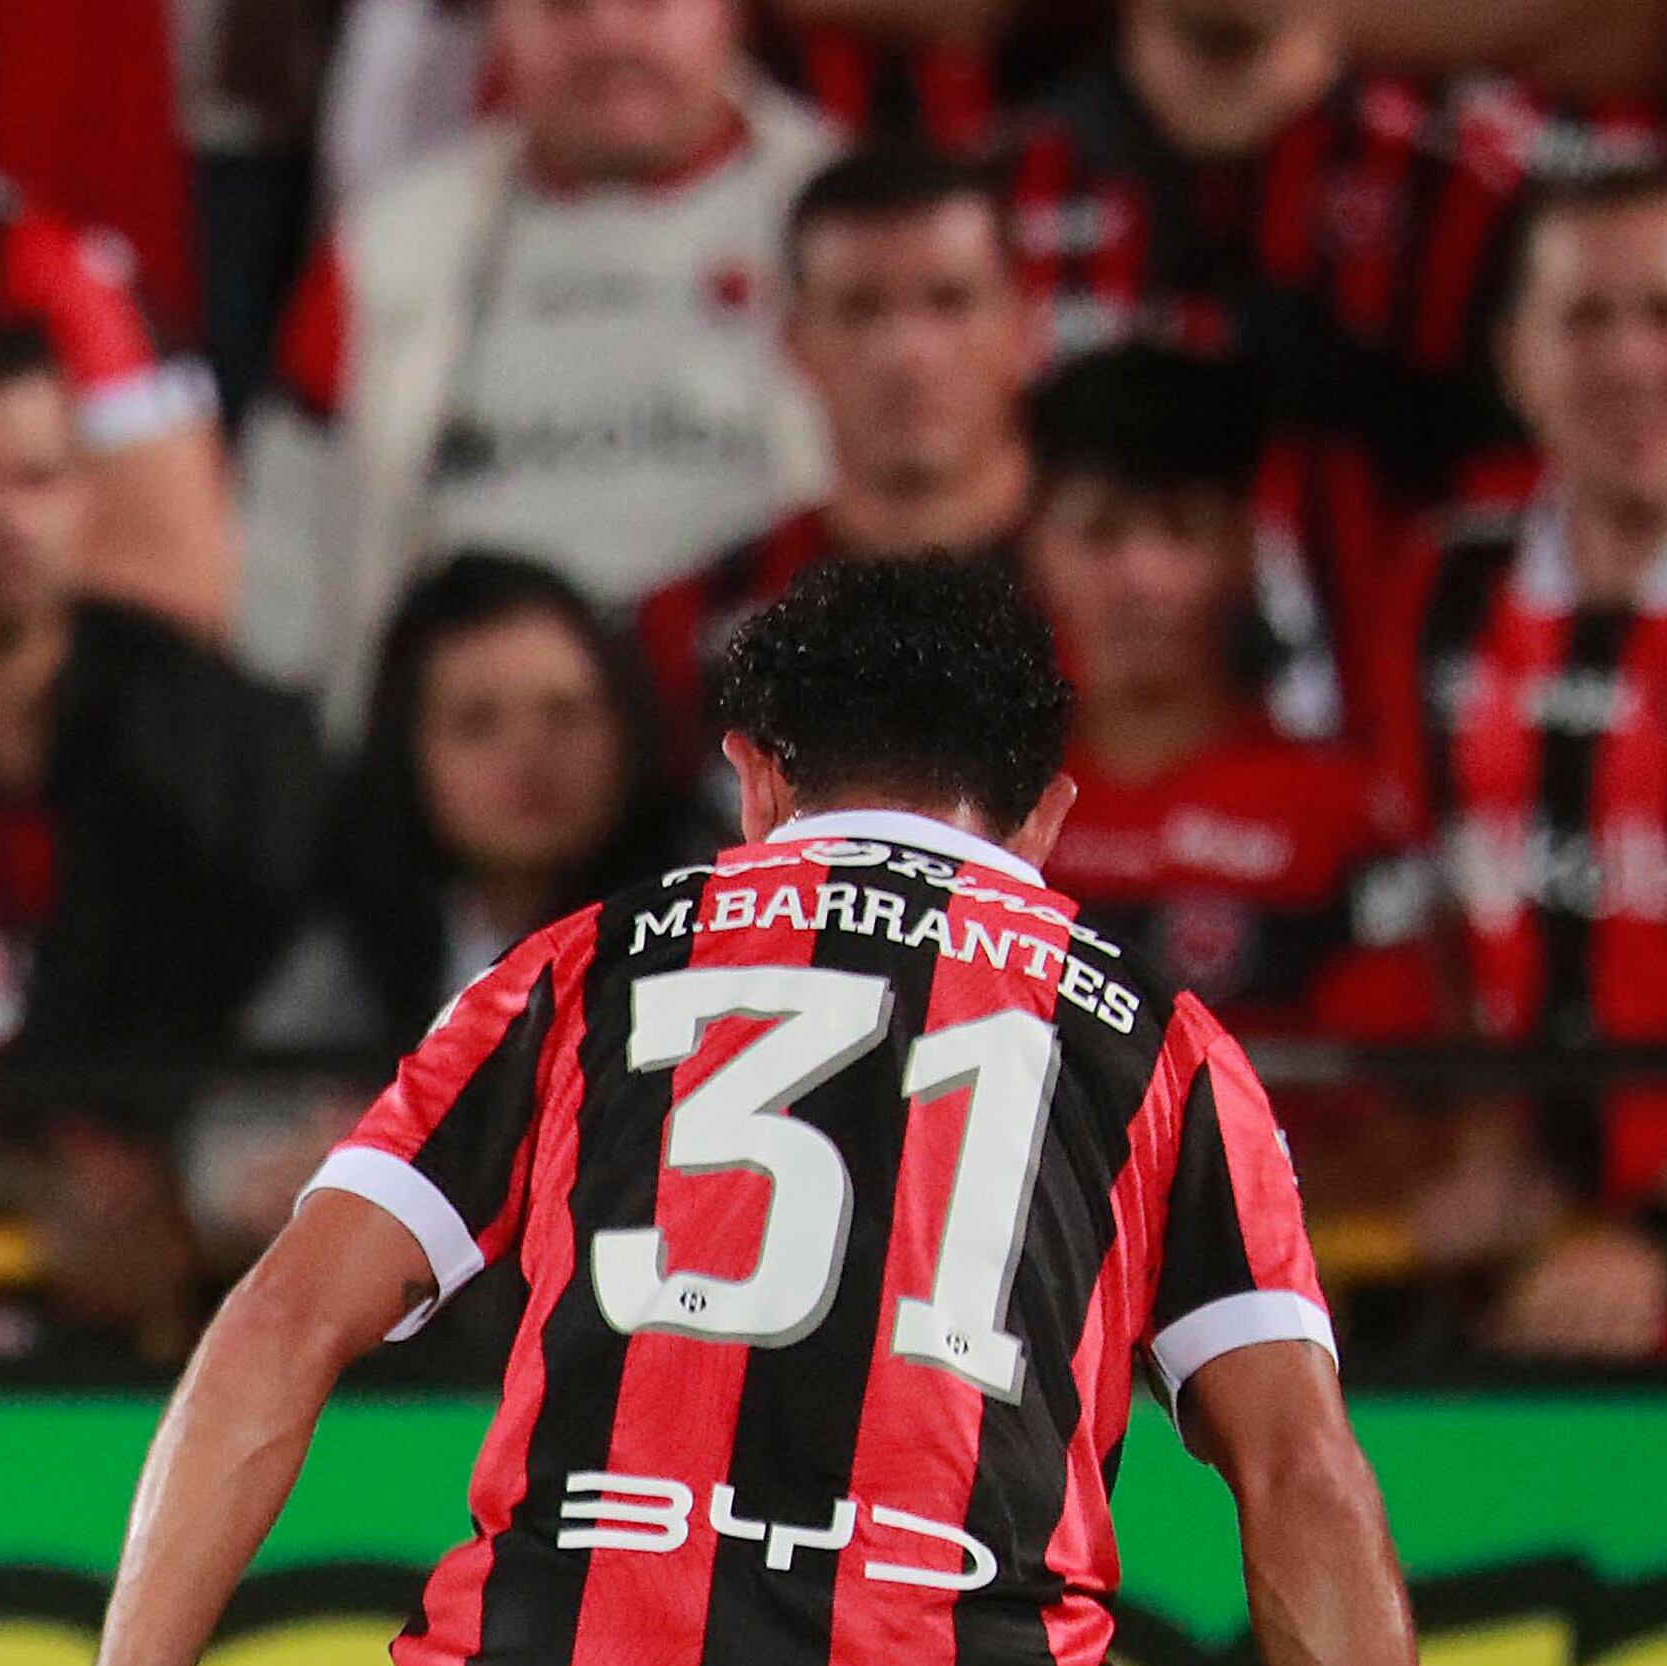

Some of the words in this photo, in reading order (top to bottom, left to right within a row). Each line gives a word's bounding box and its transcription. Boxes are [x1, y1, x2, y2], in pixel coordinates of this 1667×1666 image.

[628, 881, 1141, 1035] M.BARRANTES
[590, 965, 1061, 1404] 31
[557, 1471, 998, 1591] BYD
